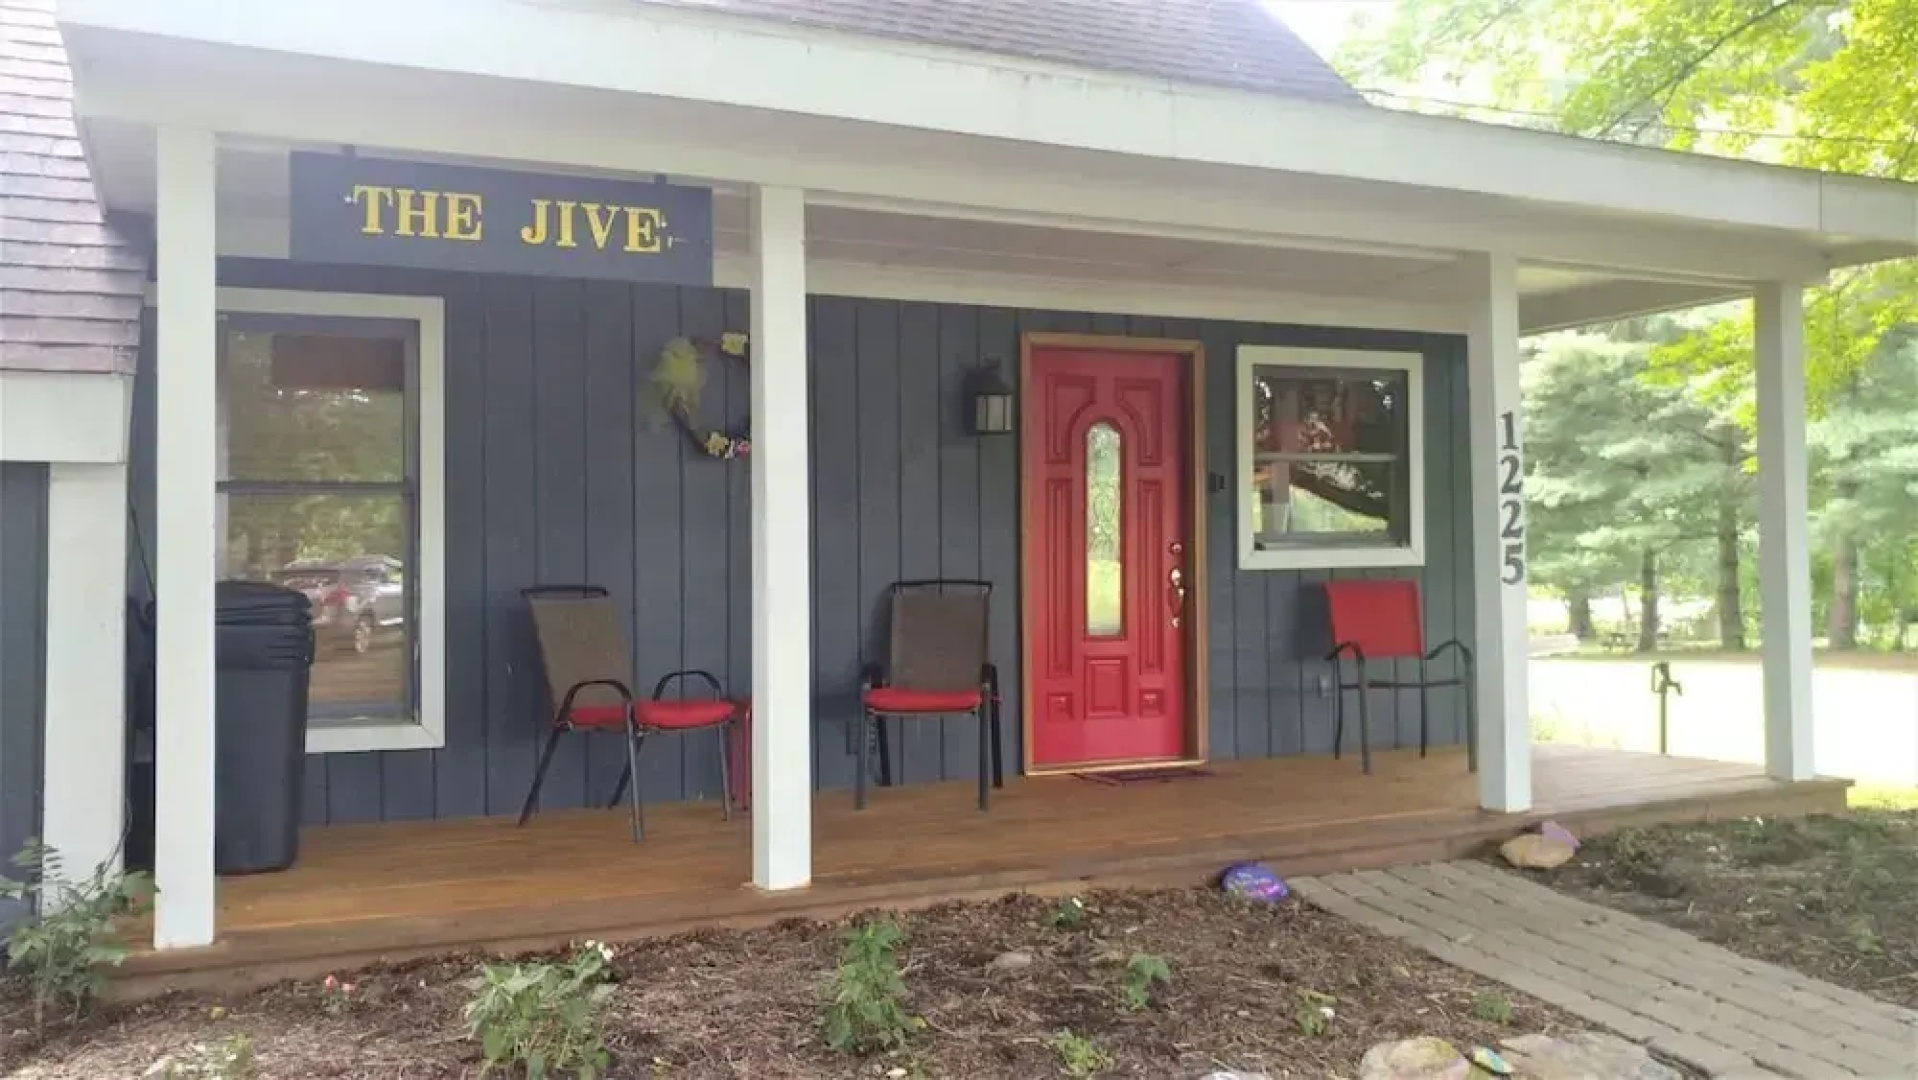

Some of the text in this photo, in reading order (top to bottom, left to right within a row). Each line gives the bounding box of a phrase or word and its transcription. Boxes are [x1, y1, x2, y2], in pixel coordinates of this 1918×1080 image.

[353, 184, 662, 253] THE JIVE
[1500, 410, 1524, 586] 1225
